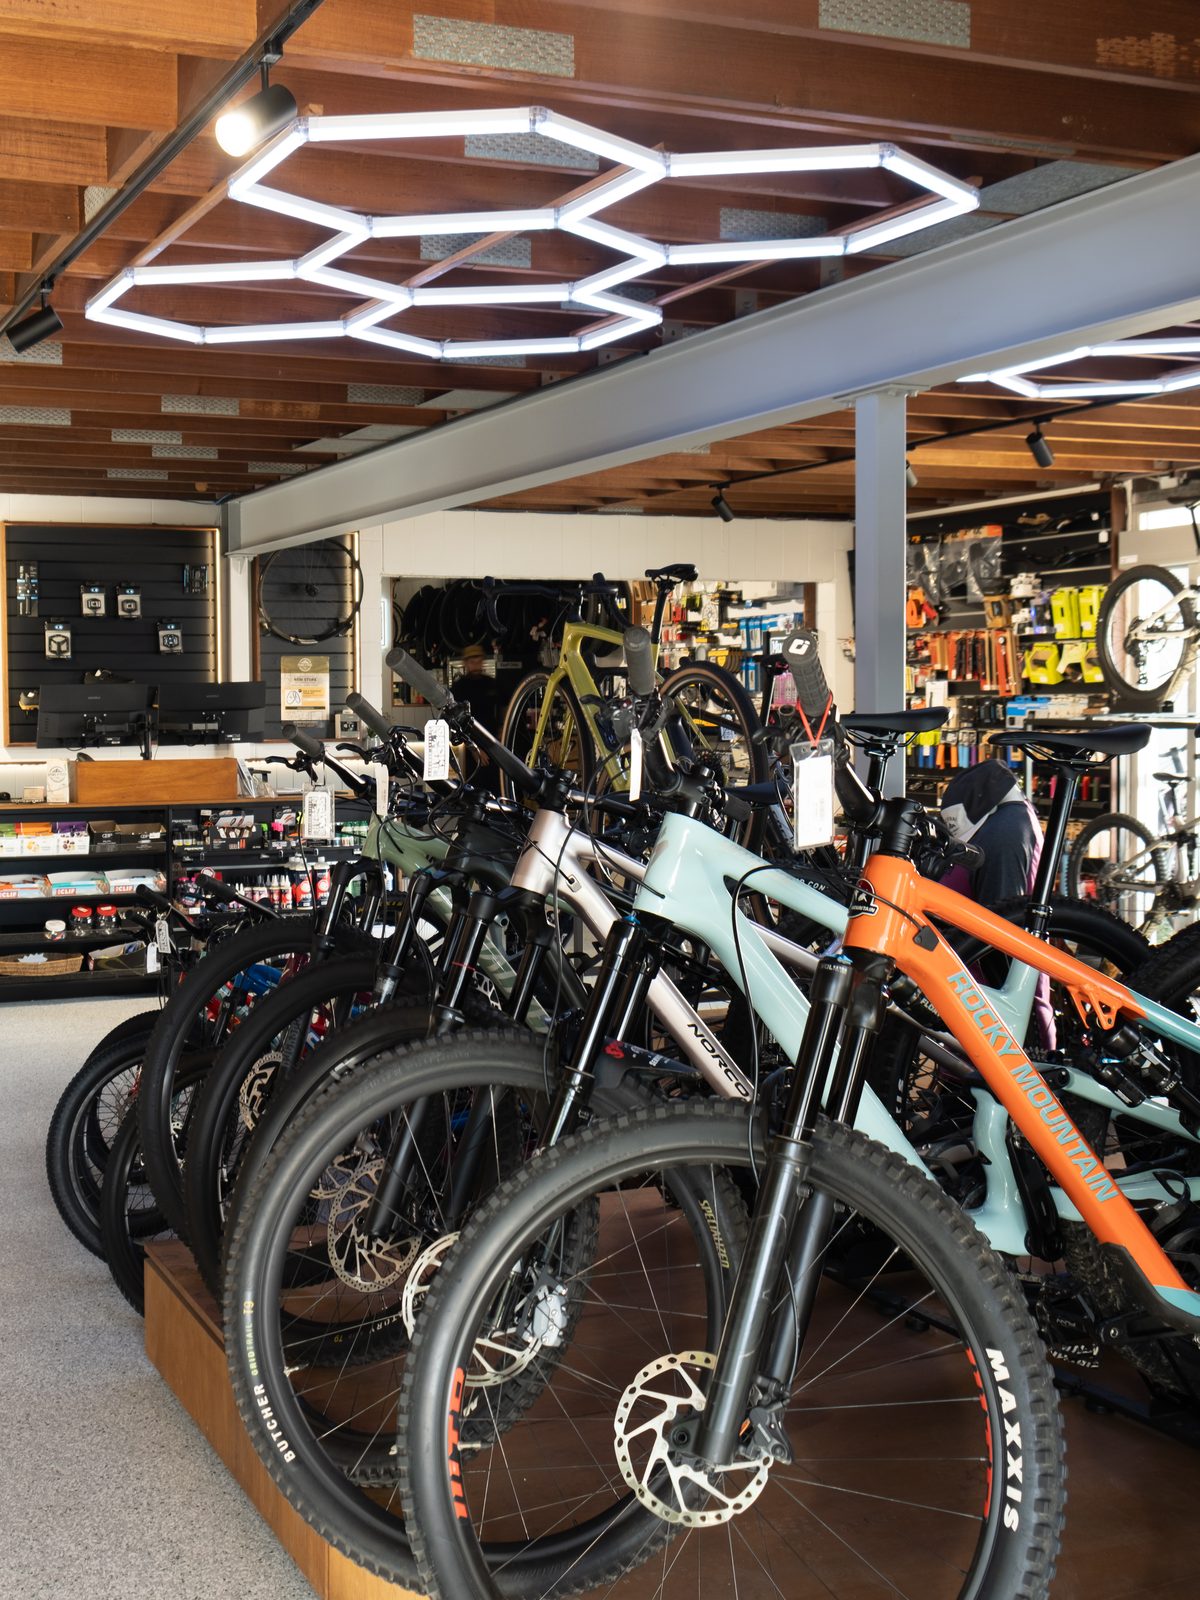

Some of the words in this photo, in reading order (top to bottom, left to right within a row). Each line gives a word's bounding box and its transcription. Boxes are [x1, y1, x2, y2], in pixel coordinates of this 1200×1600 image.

[687, 1023, 750, 1097] NORCO
[946, 970, 1021, 1058] ROCKY
[1010, 1063, 1119, 1204] MOUNTAIN
[253, 1383, 296, 1464] BUTCHER
[985, 1347, 1023, 1533] MAXXIS
